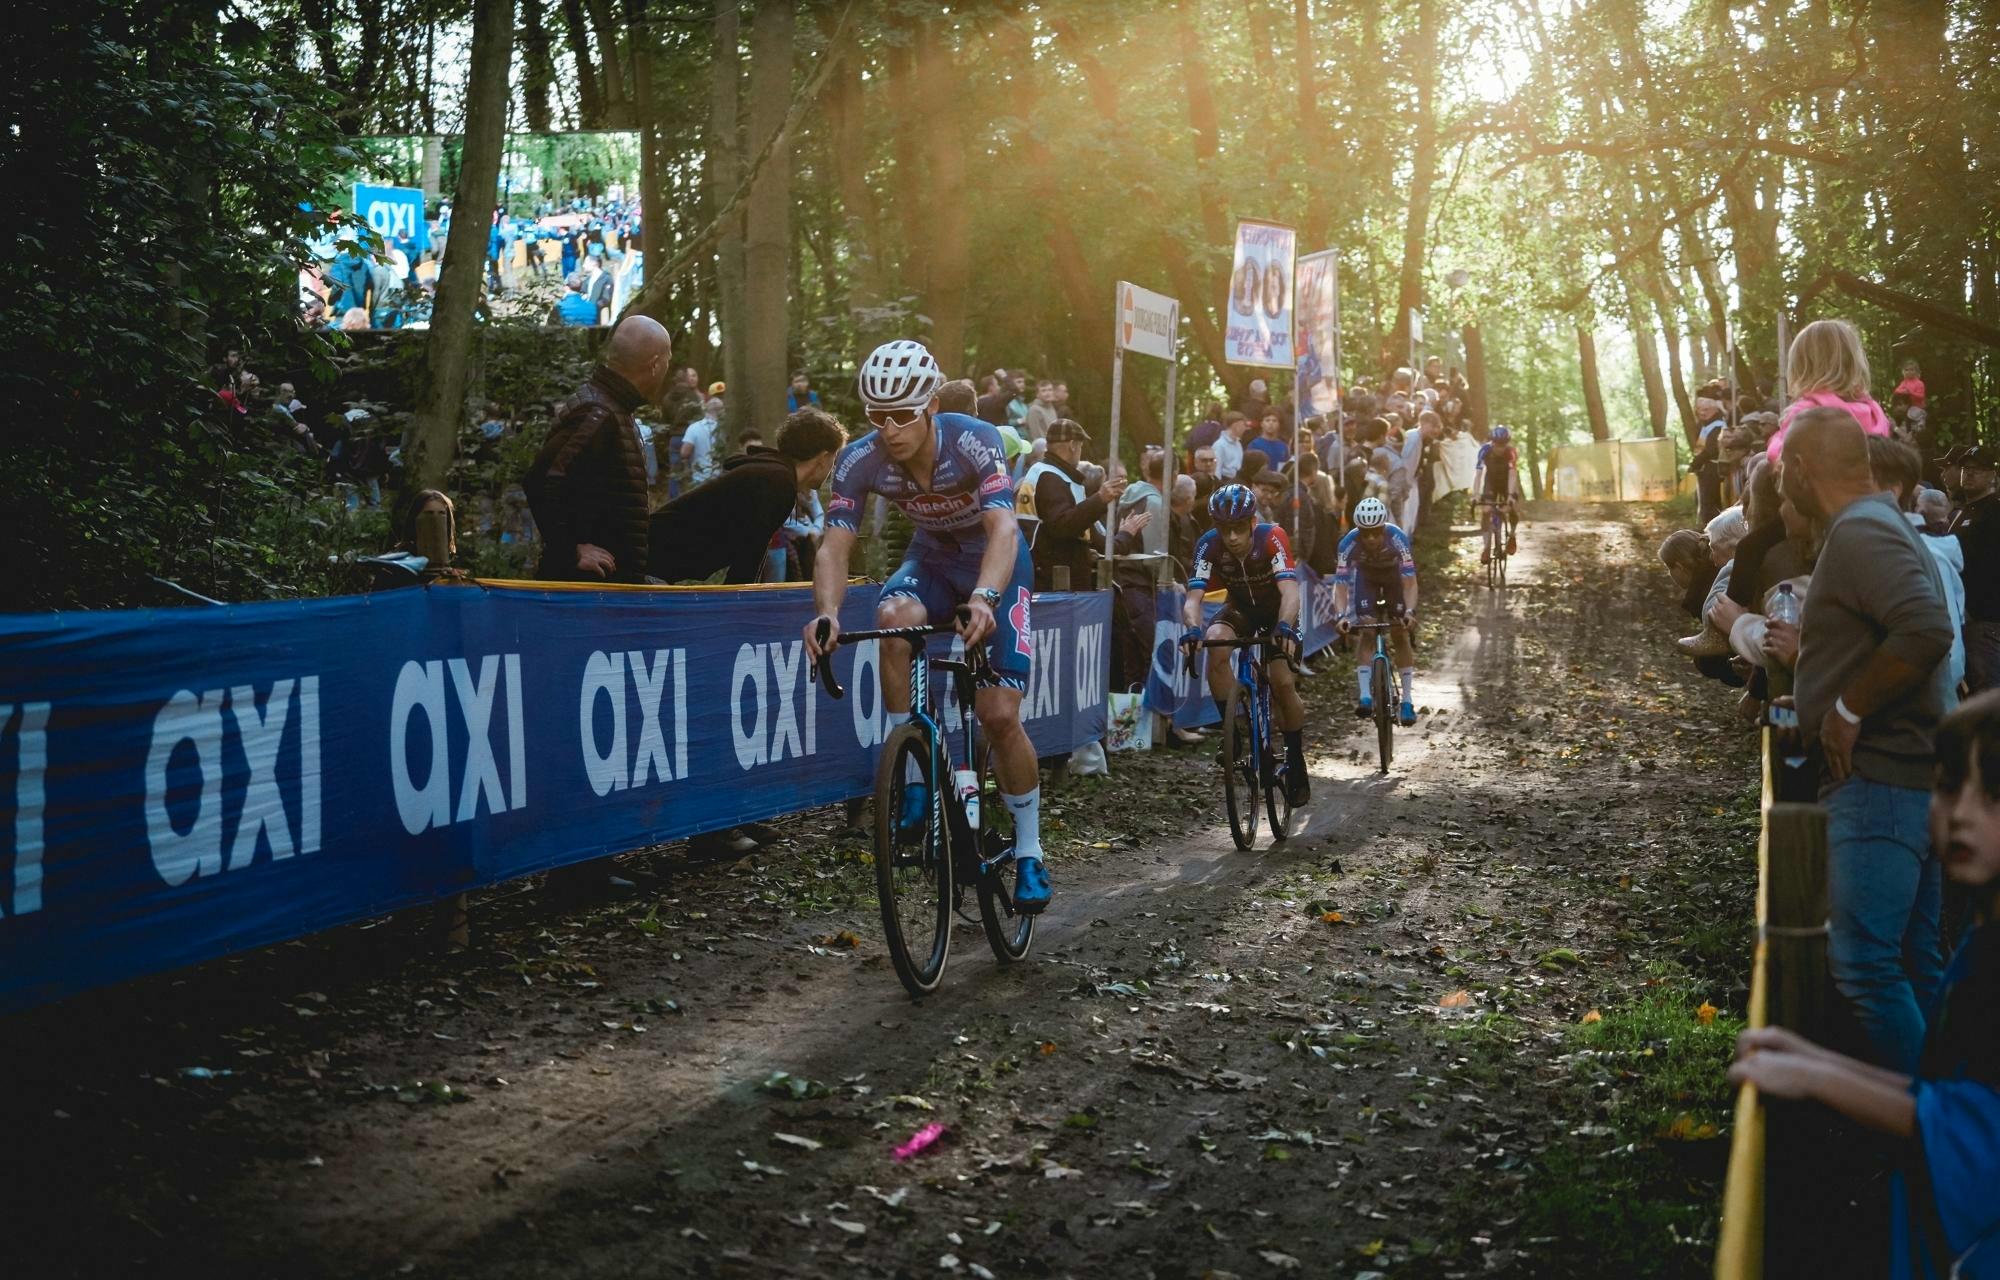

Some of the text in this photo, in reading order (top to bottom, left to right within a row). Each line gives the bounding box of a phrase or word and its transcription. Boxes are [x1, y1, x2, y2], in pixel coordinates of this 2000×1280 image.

[367, 200, 415, 238] axi
[835, 440, 877, 483] deceuninck
[957, 430, 992, 470] Alpecin
[906, 498, 964, 514] Alpecin
[1020, 597, 1031, 648] Alpecin
[145, 675, 321, 887] axi
[390, 653, 527, 835] axi
[580, 647, 689, 797] axi
[731, 640, 816, 771] axi
[1076, 622, 1103, 712] axi
